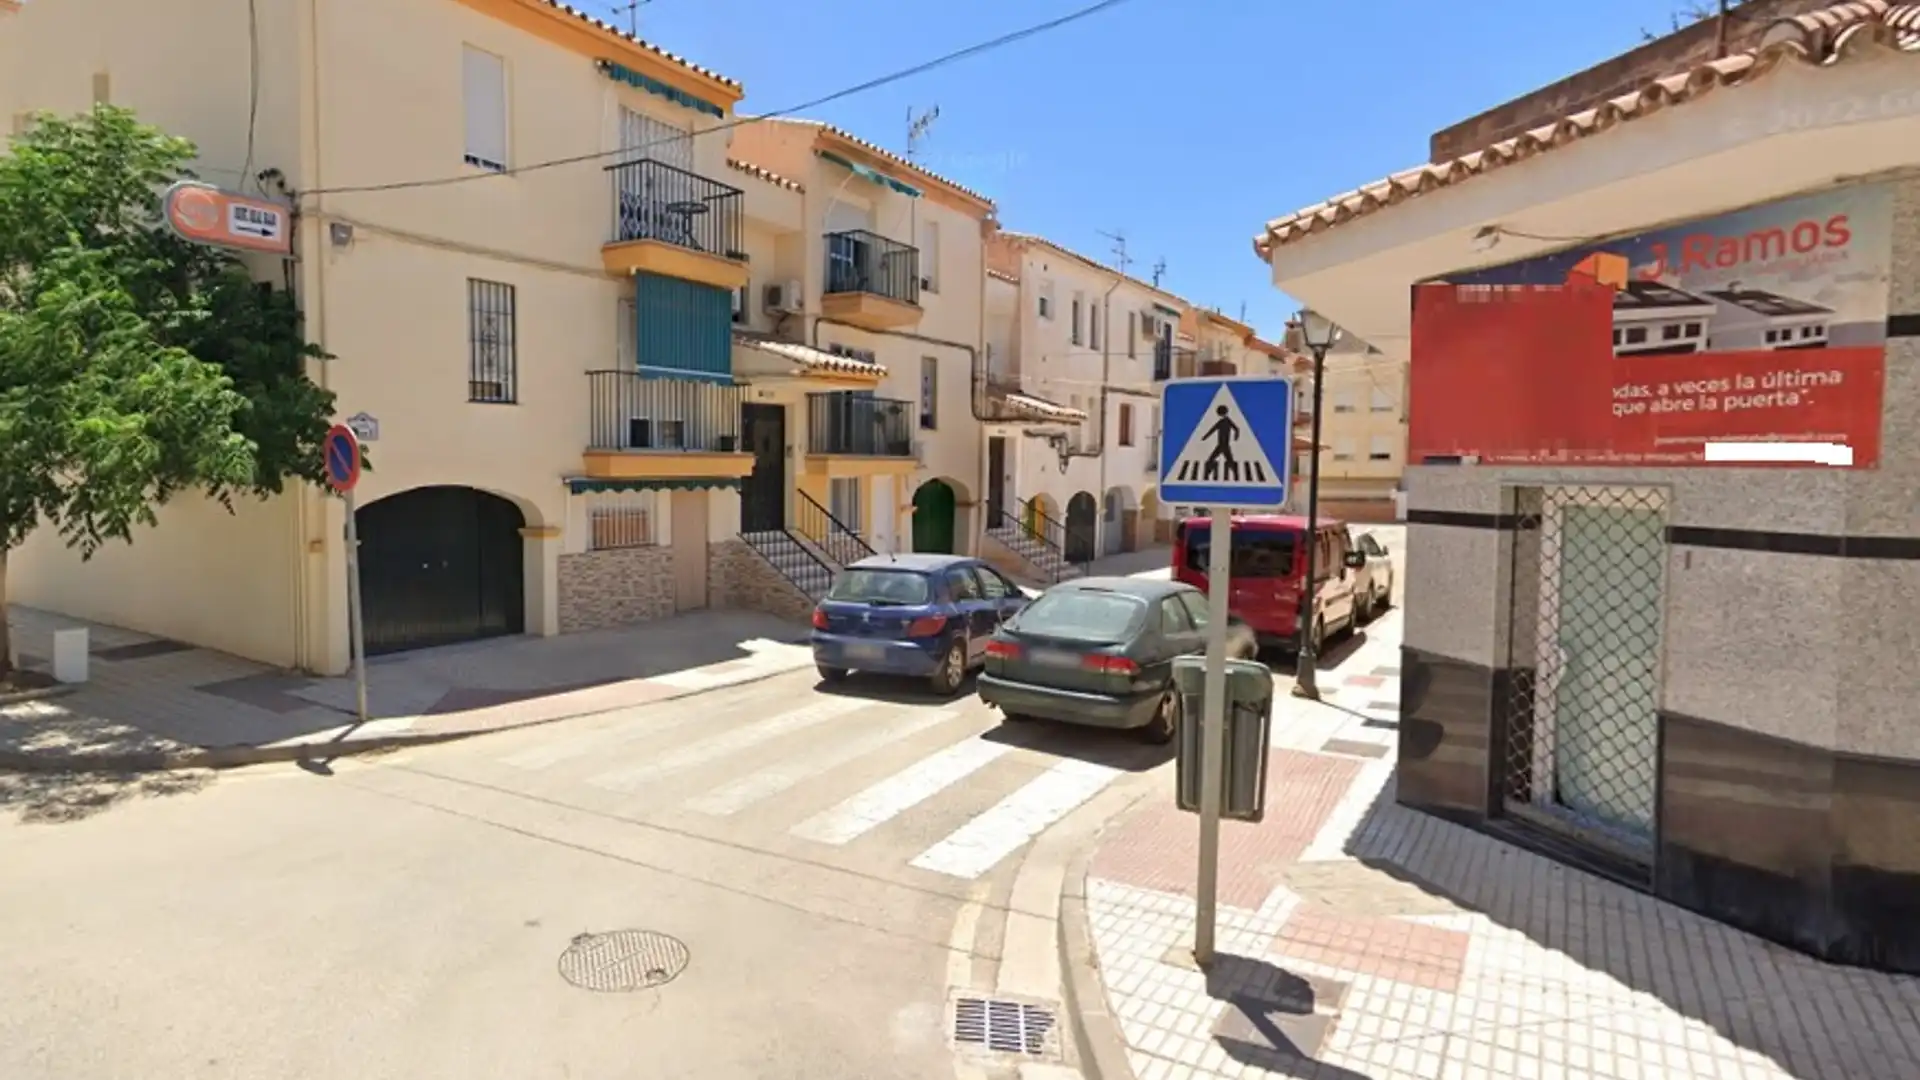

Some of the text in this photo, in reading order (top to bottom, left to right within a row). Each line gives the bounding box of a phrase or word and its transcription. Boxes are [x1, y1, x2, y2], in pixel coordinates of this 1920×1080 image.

[1657, 382, 1669, 396] a
[1673, 376, 1730, 394] veces
[1735, 373, 1756, 390] la
[1761, 369, 1844, 389] última
[1612, 402, 1646, 418] que
[1650, 396, 1696, 413] abre
[1699, 393, 1718, 411] la
